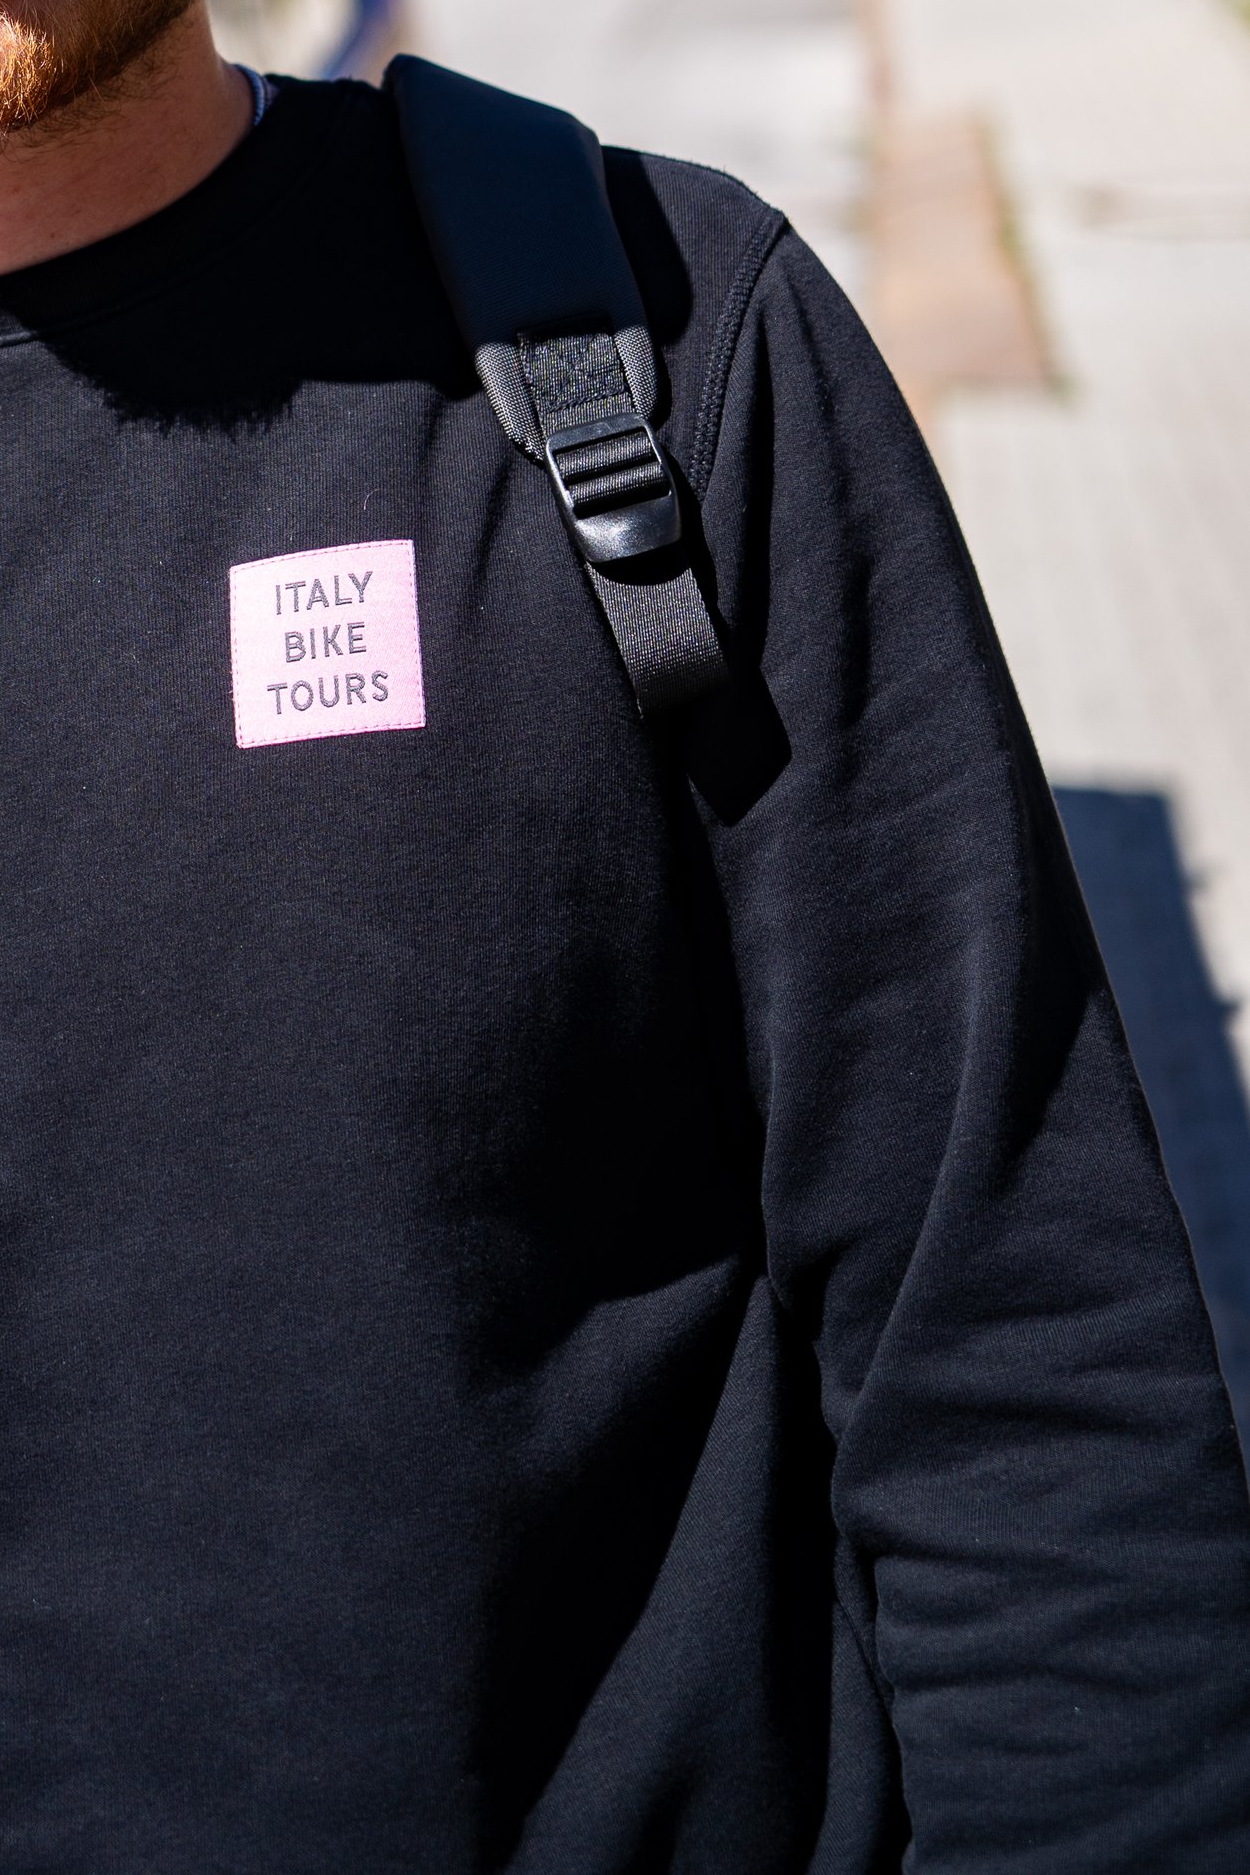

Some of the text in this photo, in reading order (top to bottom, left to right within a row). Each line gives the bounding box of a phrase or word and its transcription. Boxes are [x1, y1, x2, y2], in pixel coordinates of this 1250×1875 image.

[274, 571, 373, 615] ITALY
[285, 621, 367, 663] BIKE
[267, 670, 389, 715] TOURS
